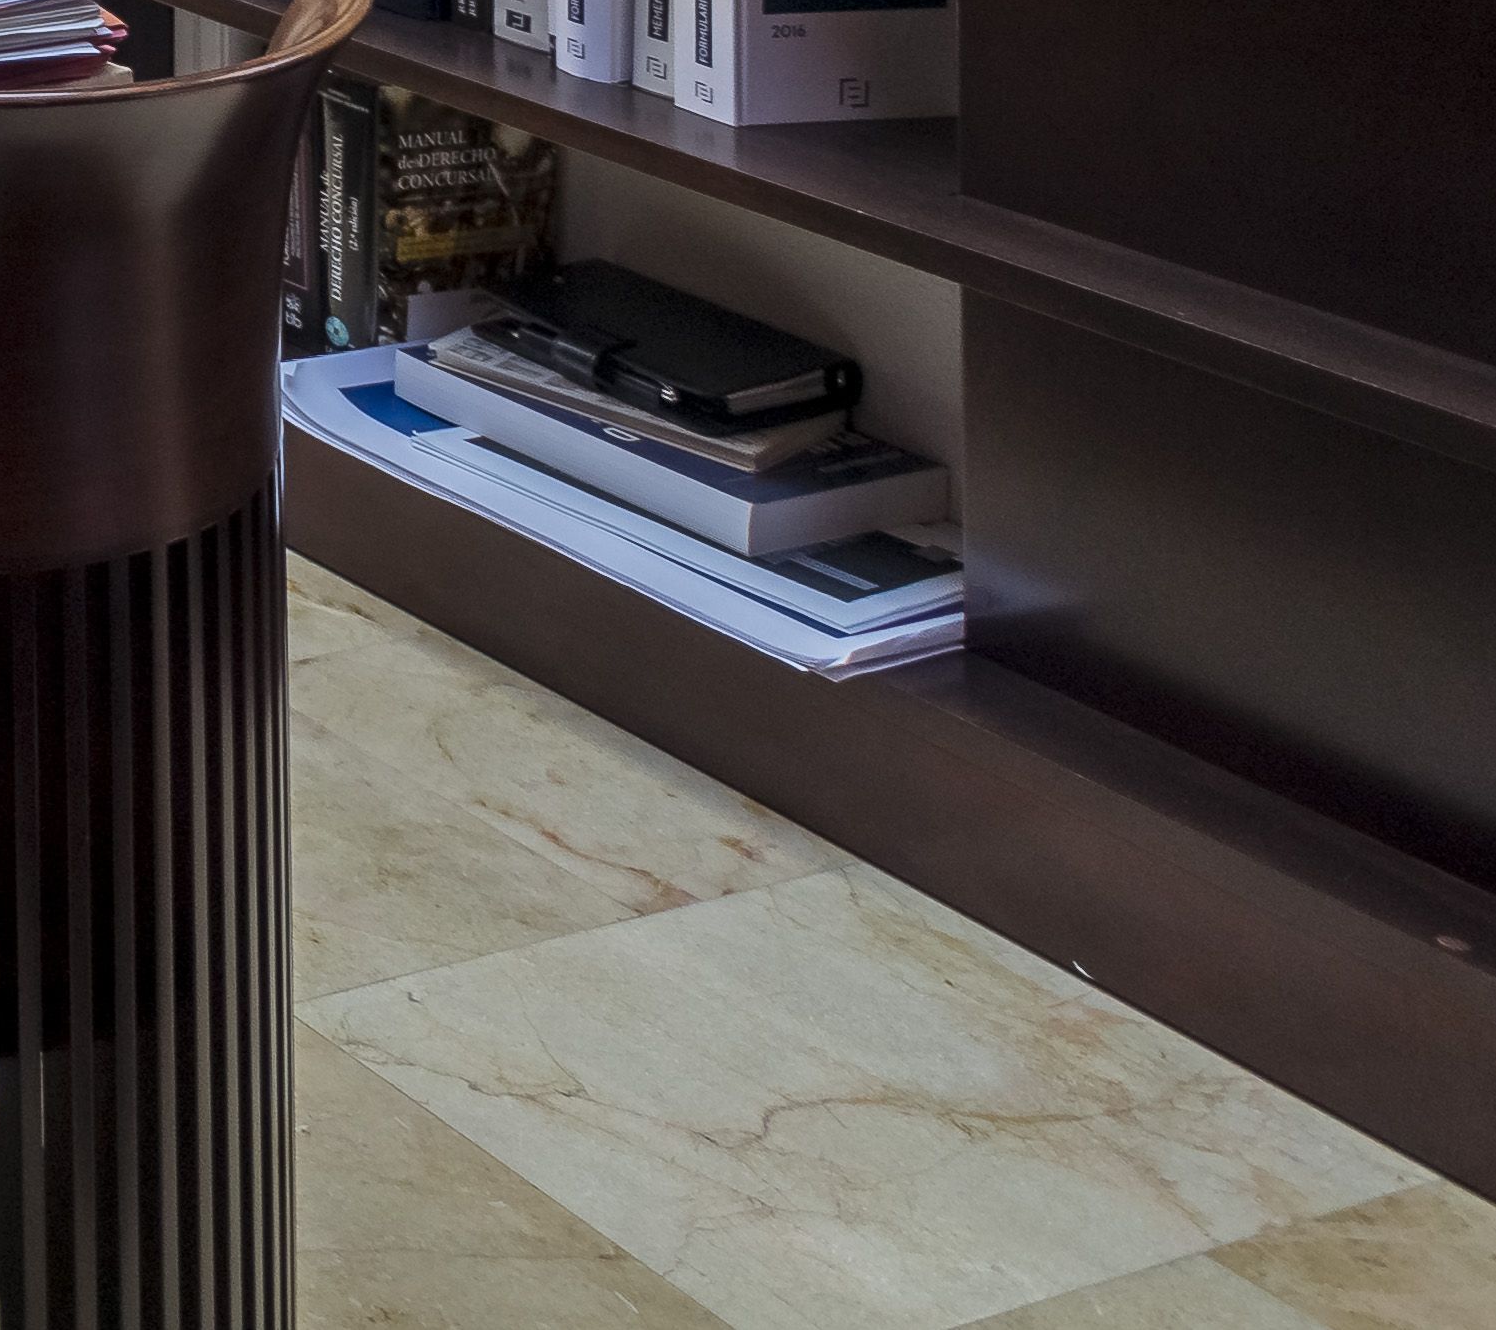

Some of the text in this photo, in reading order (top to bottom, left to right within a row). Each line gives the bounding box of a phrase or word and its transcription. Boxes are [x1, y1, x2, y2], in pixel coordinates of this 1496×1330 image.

[770, 24, 806, 40] 2016
[397, 130, 466, 149] MANUAL
[319, 190, 331, 252] MANUAL
[330, 133, 343, 302] DERECHO CONCURSAL
